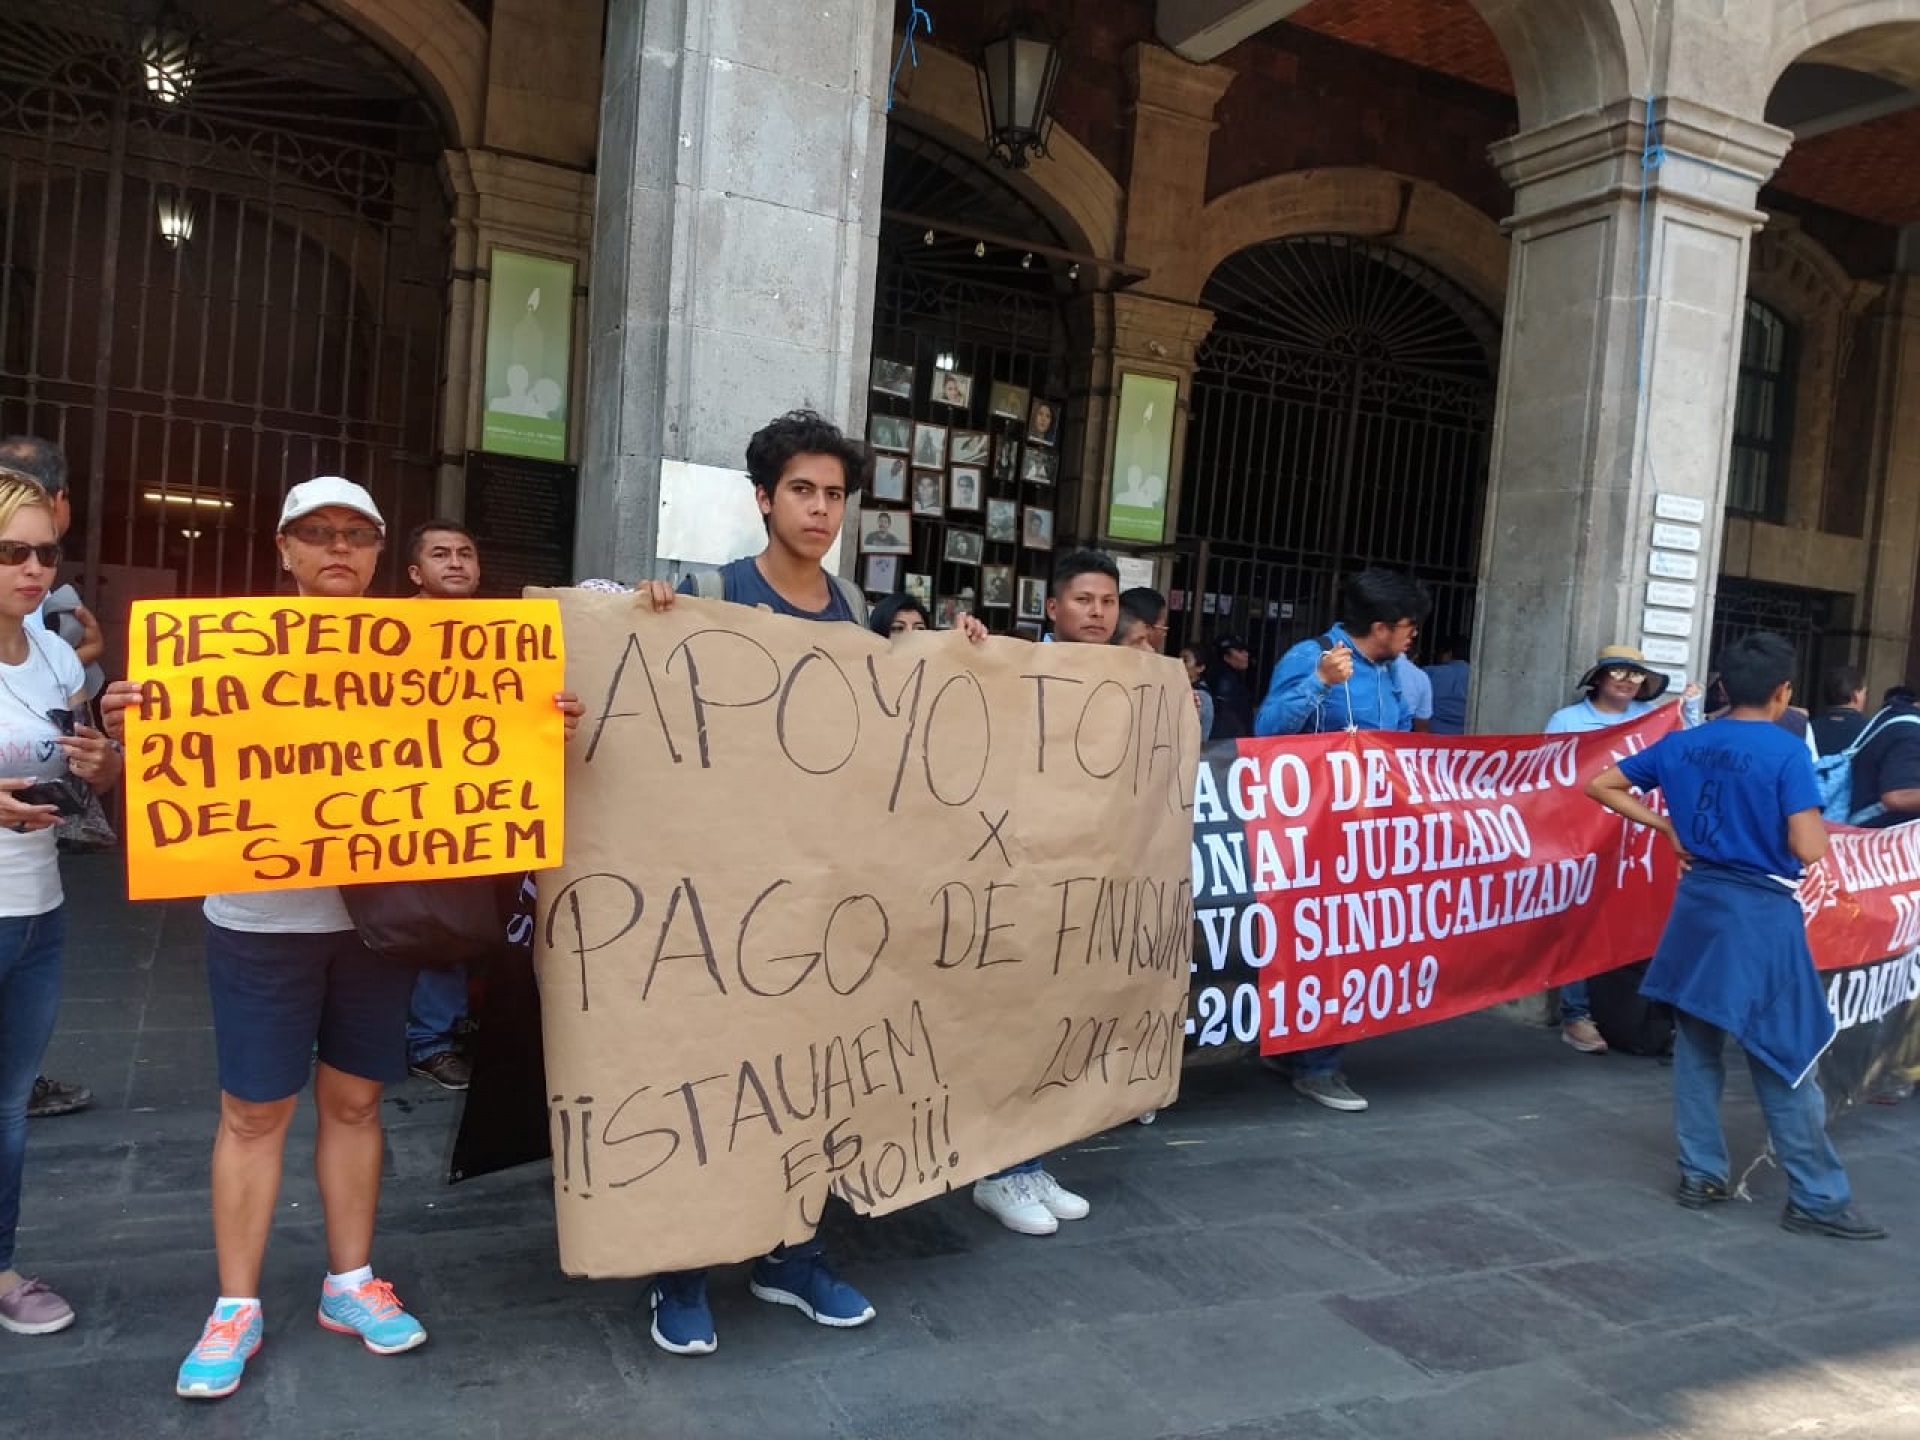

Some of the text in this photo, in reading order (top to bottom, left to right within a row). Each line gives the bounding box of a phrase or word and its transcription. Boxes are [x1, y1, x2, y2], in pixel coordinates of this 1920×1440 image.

[143, 608, 558, 667] RESPETO TOTAL
[139, 665, 525, 721] A LA CLAUSÚLA
[584, 629, 1194, 816] APOYO TOTAL
[141, 714, 501, 788] 29 numeral 8
[1325, 748, 1394, 812] DE
[1394, 737, 1580, 806] FINIQUITO
[146, 779, 541, 848] DEL CCT DEL
[241, 818, 547, 880] STAUAEM
[1334, 803, 1533, 884] JUBILADO
[545, 872, 891, 1011] PAGO
[931, 879, 1024, 971] DE
[1190, 852, 1598, 973] VO SINDICALIZADO
[780, 1116, 863, 1194] ES
